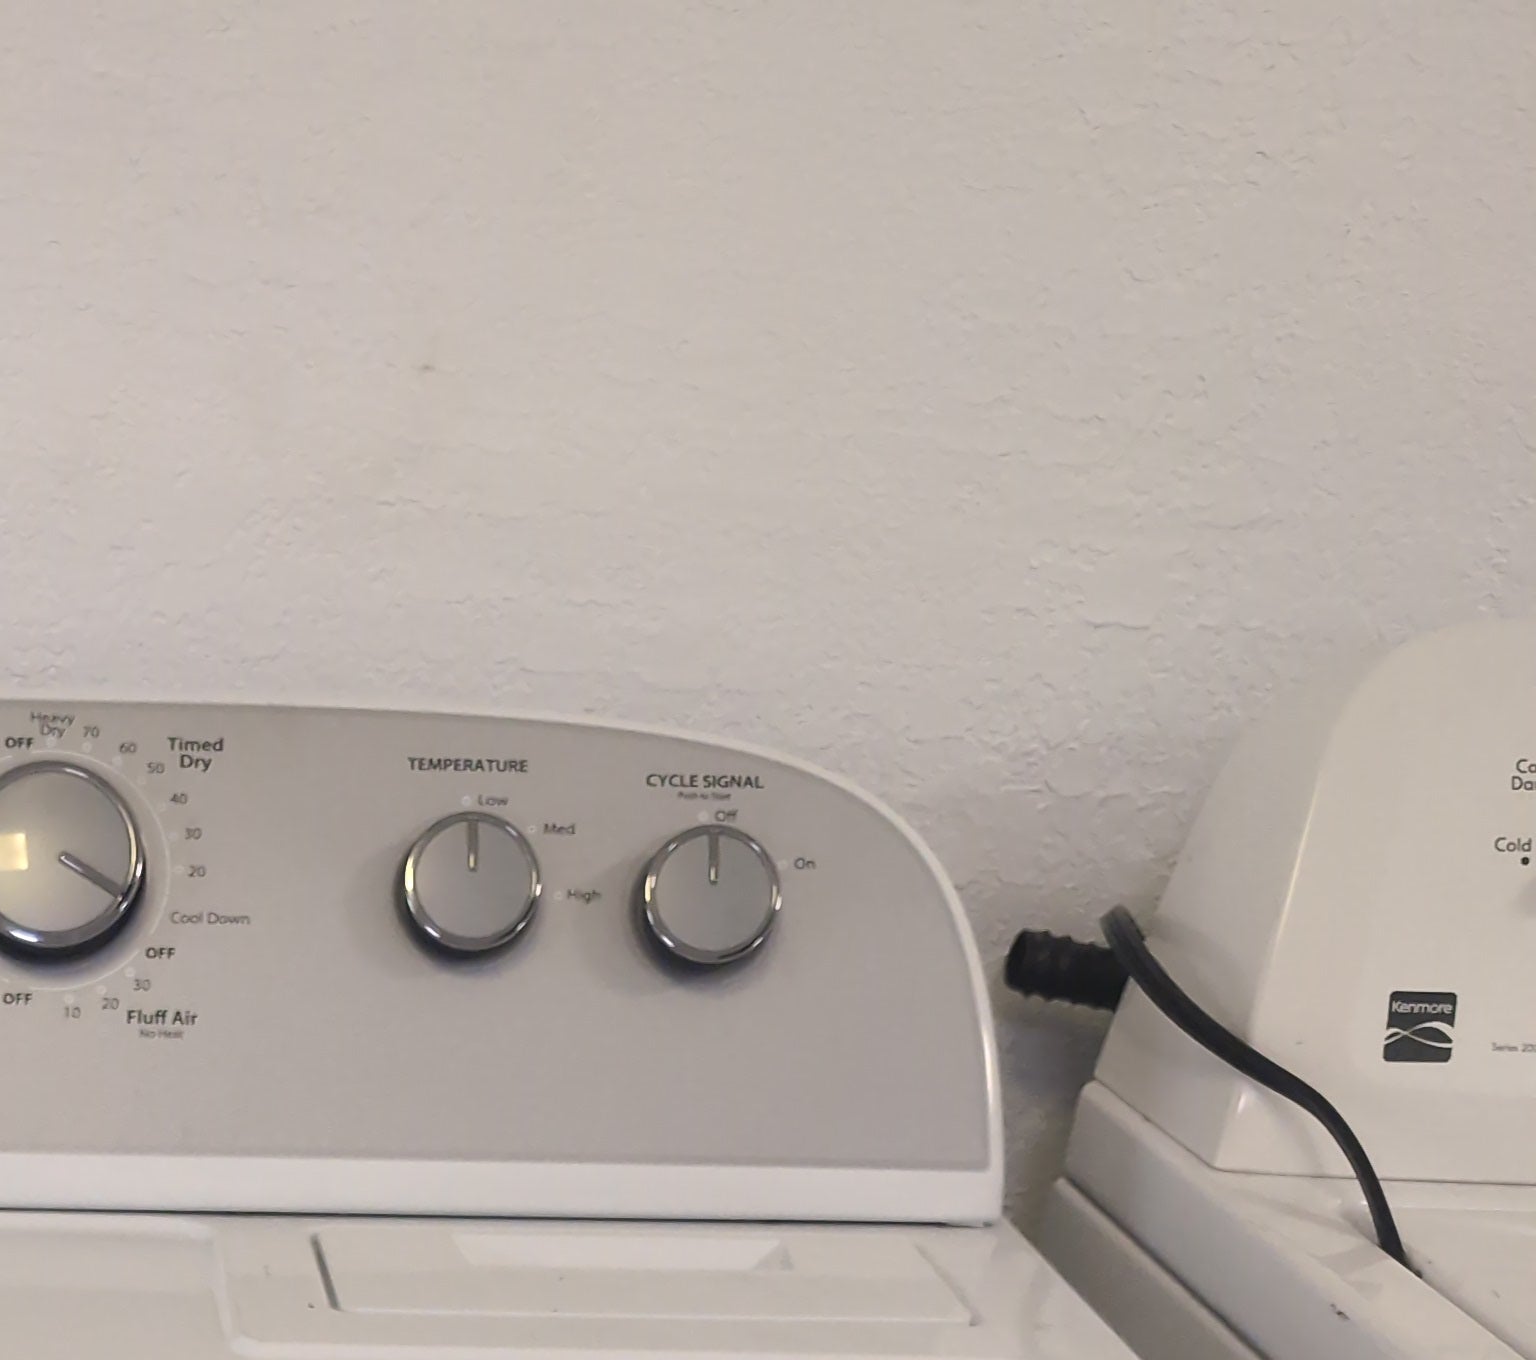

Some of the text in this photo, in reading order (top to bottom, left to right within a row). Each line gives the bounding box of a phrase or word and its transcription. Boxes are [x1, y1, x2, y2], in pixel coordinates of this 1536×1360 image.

[39, 723, 66, 738] Dry
[82, 726, 100, 738] 70
[5, 737, 34, 749] OFF
[119, 742, 137, 754] 60
[167, 737, 225, 752] Timed
[147, 762, 165, 774] 50
[179, 754, 213, 773] Dry
[408, 757, 529, 773] TEMPERATURE
[646, 773, 765, 790] CYCLE SIGNAL
[170, 793, 187, 805] 40
[478, 794, 509, 806] Low
[715, 809, 739, 822] Off
[184, 827, 203, 840] 30
[543, 822, 576, 836] Med
[1494, 837, 1532, 852] Cold
[793, 857, 816, 870] On
[188, 865, 206, 878] 20
[170, 911, 251, 925] Cool Down
[144, 947, 176, 959] OFF
[132, 978, 151, 992] 30
[2, 993, 33, 1005] OFF
[101, 997, 120, 1010] 20
[64, 1006, 81, 1019] 10
[1391, 1000, 1454, 1014] Kenmore
[125, 1009, 198, 1026] Fluff Air
